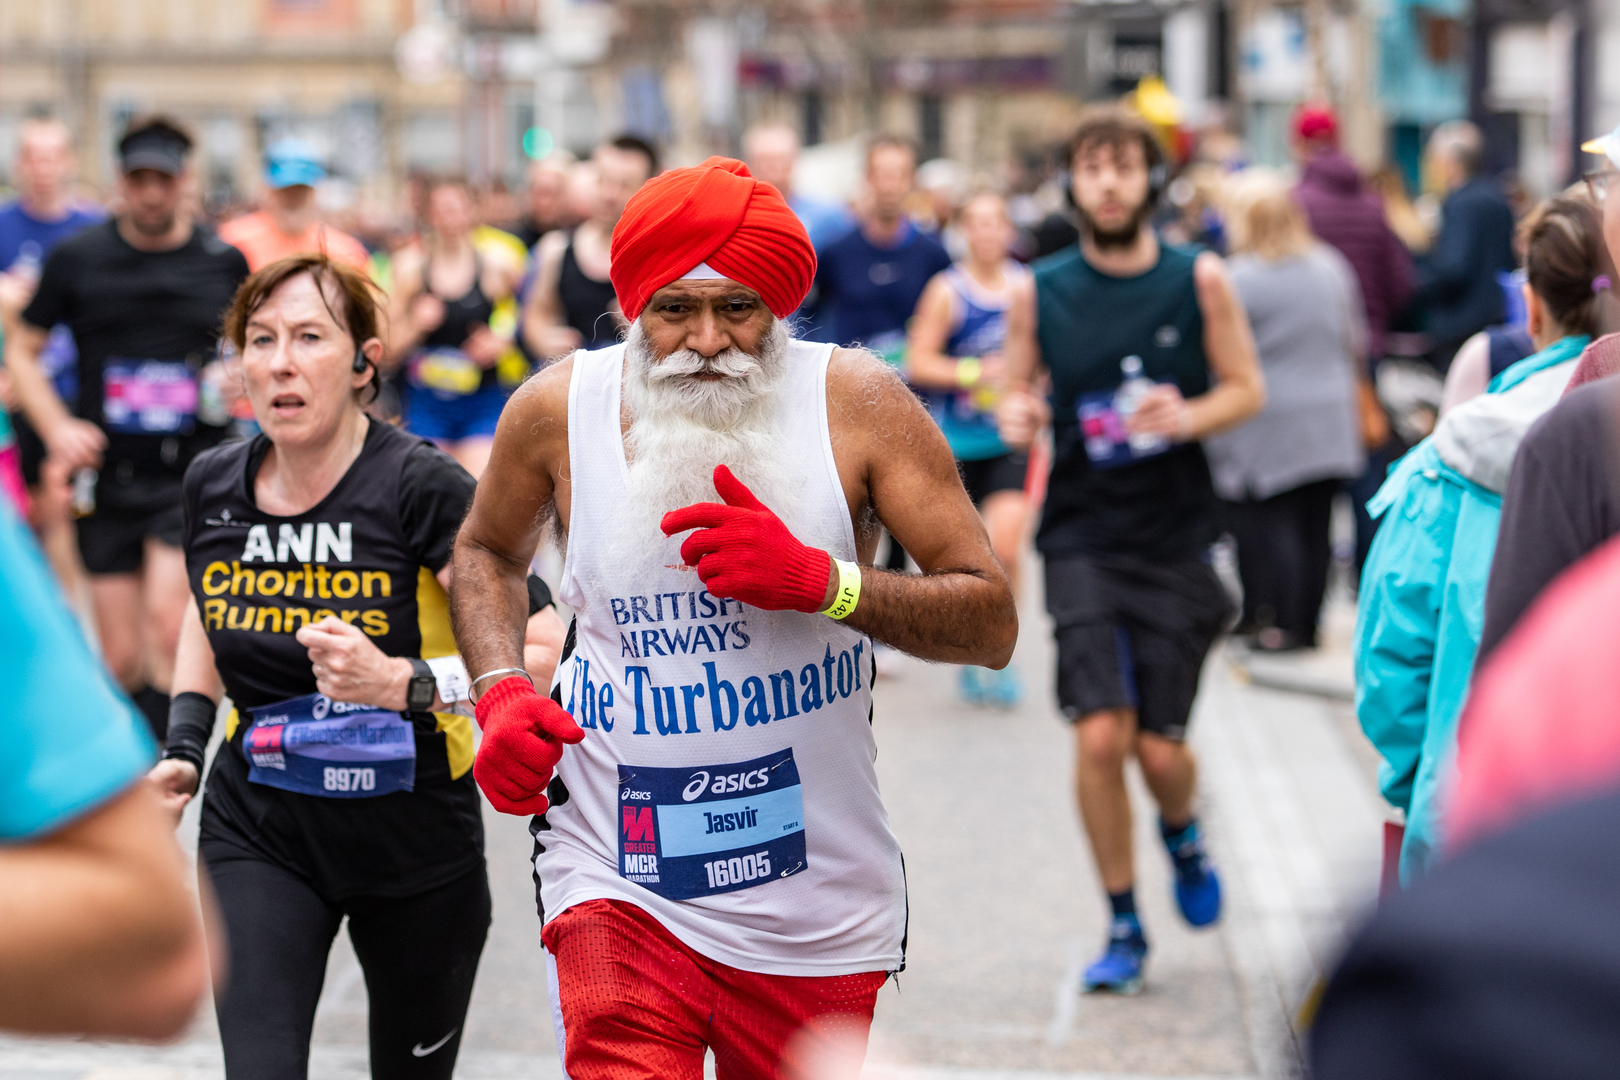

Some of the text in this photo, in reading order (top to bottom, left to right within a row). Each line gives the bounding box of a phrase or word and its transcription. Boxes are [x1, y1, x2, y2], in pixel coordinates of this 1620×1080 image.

[241, 521, 353, 563] ANN
[202, 560, 392, 599] Chorlton
[610, 589, 744, 626] BRITISH
[830, 587, 854, 616] J142
[203, 598, 391, 637] Runners
[620, 620, 751, 658] AIRWAYS
[566, 639, 864, 736] The Turbanator
[323, 766, 376, 792] 8970
[711, 766, 769, 794] asics
[630, 789, 651, 800] asics
[624, 807, 635, 816] 2019
[703, 806, 758, 835] Jasvir
[624, 842, 656, 854] GREATER
[624, 854, 659, 874] MCR
[704, 850, 772, 888] 16005
[625, 874, 660, 884] MARATHON
